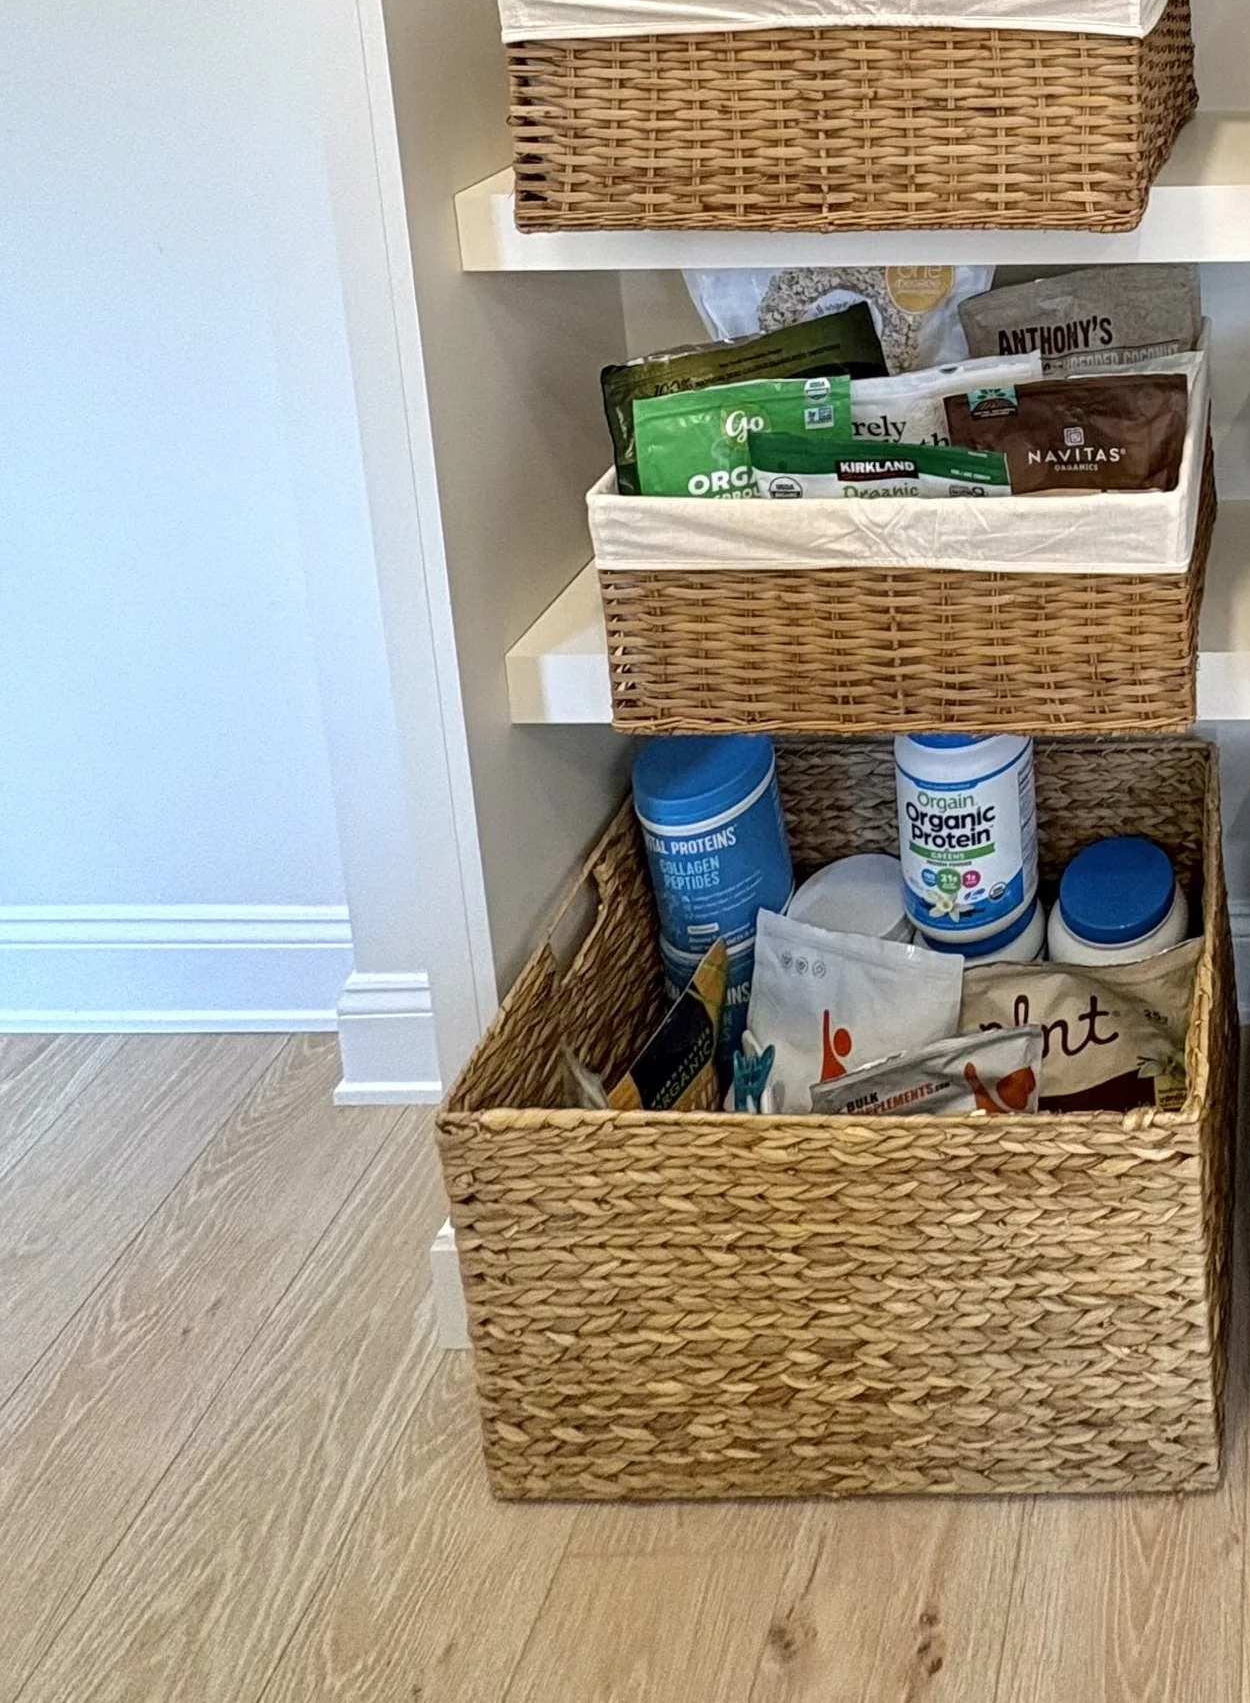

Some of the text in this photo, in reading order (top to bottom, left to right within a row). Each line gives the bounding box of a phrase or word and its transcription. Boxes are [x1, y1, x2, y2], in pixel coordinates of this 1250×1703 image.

[998, 315, 1113, 356] ANTHONY'S
[725, 410, 764, 443] Go
[840, 461, 915, 473] KIRKLAND
[1028, 448, 1121, 465] NAVITAS
[917, 791, 975, 813] Orgain
[905, 801, 997, 833] Organic
[670, 826, 737, 856] PROTEINS
[911, 822, 991, 849] Protein
[660, 855, 720, 876] COLLAGEN
[931, 851, 965, 860] GREENS
[664, 871, 720, 890] PEPTIDES
[846, 1091, 879, 1114] BULK
